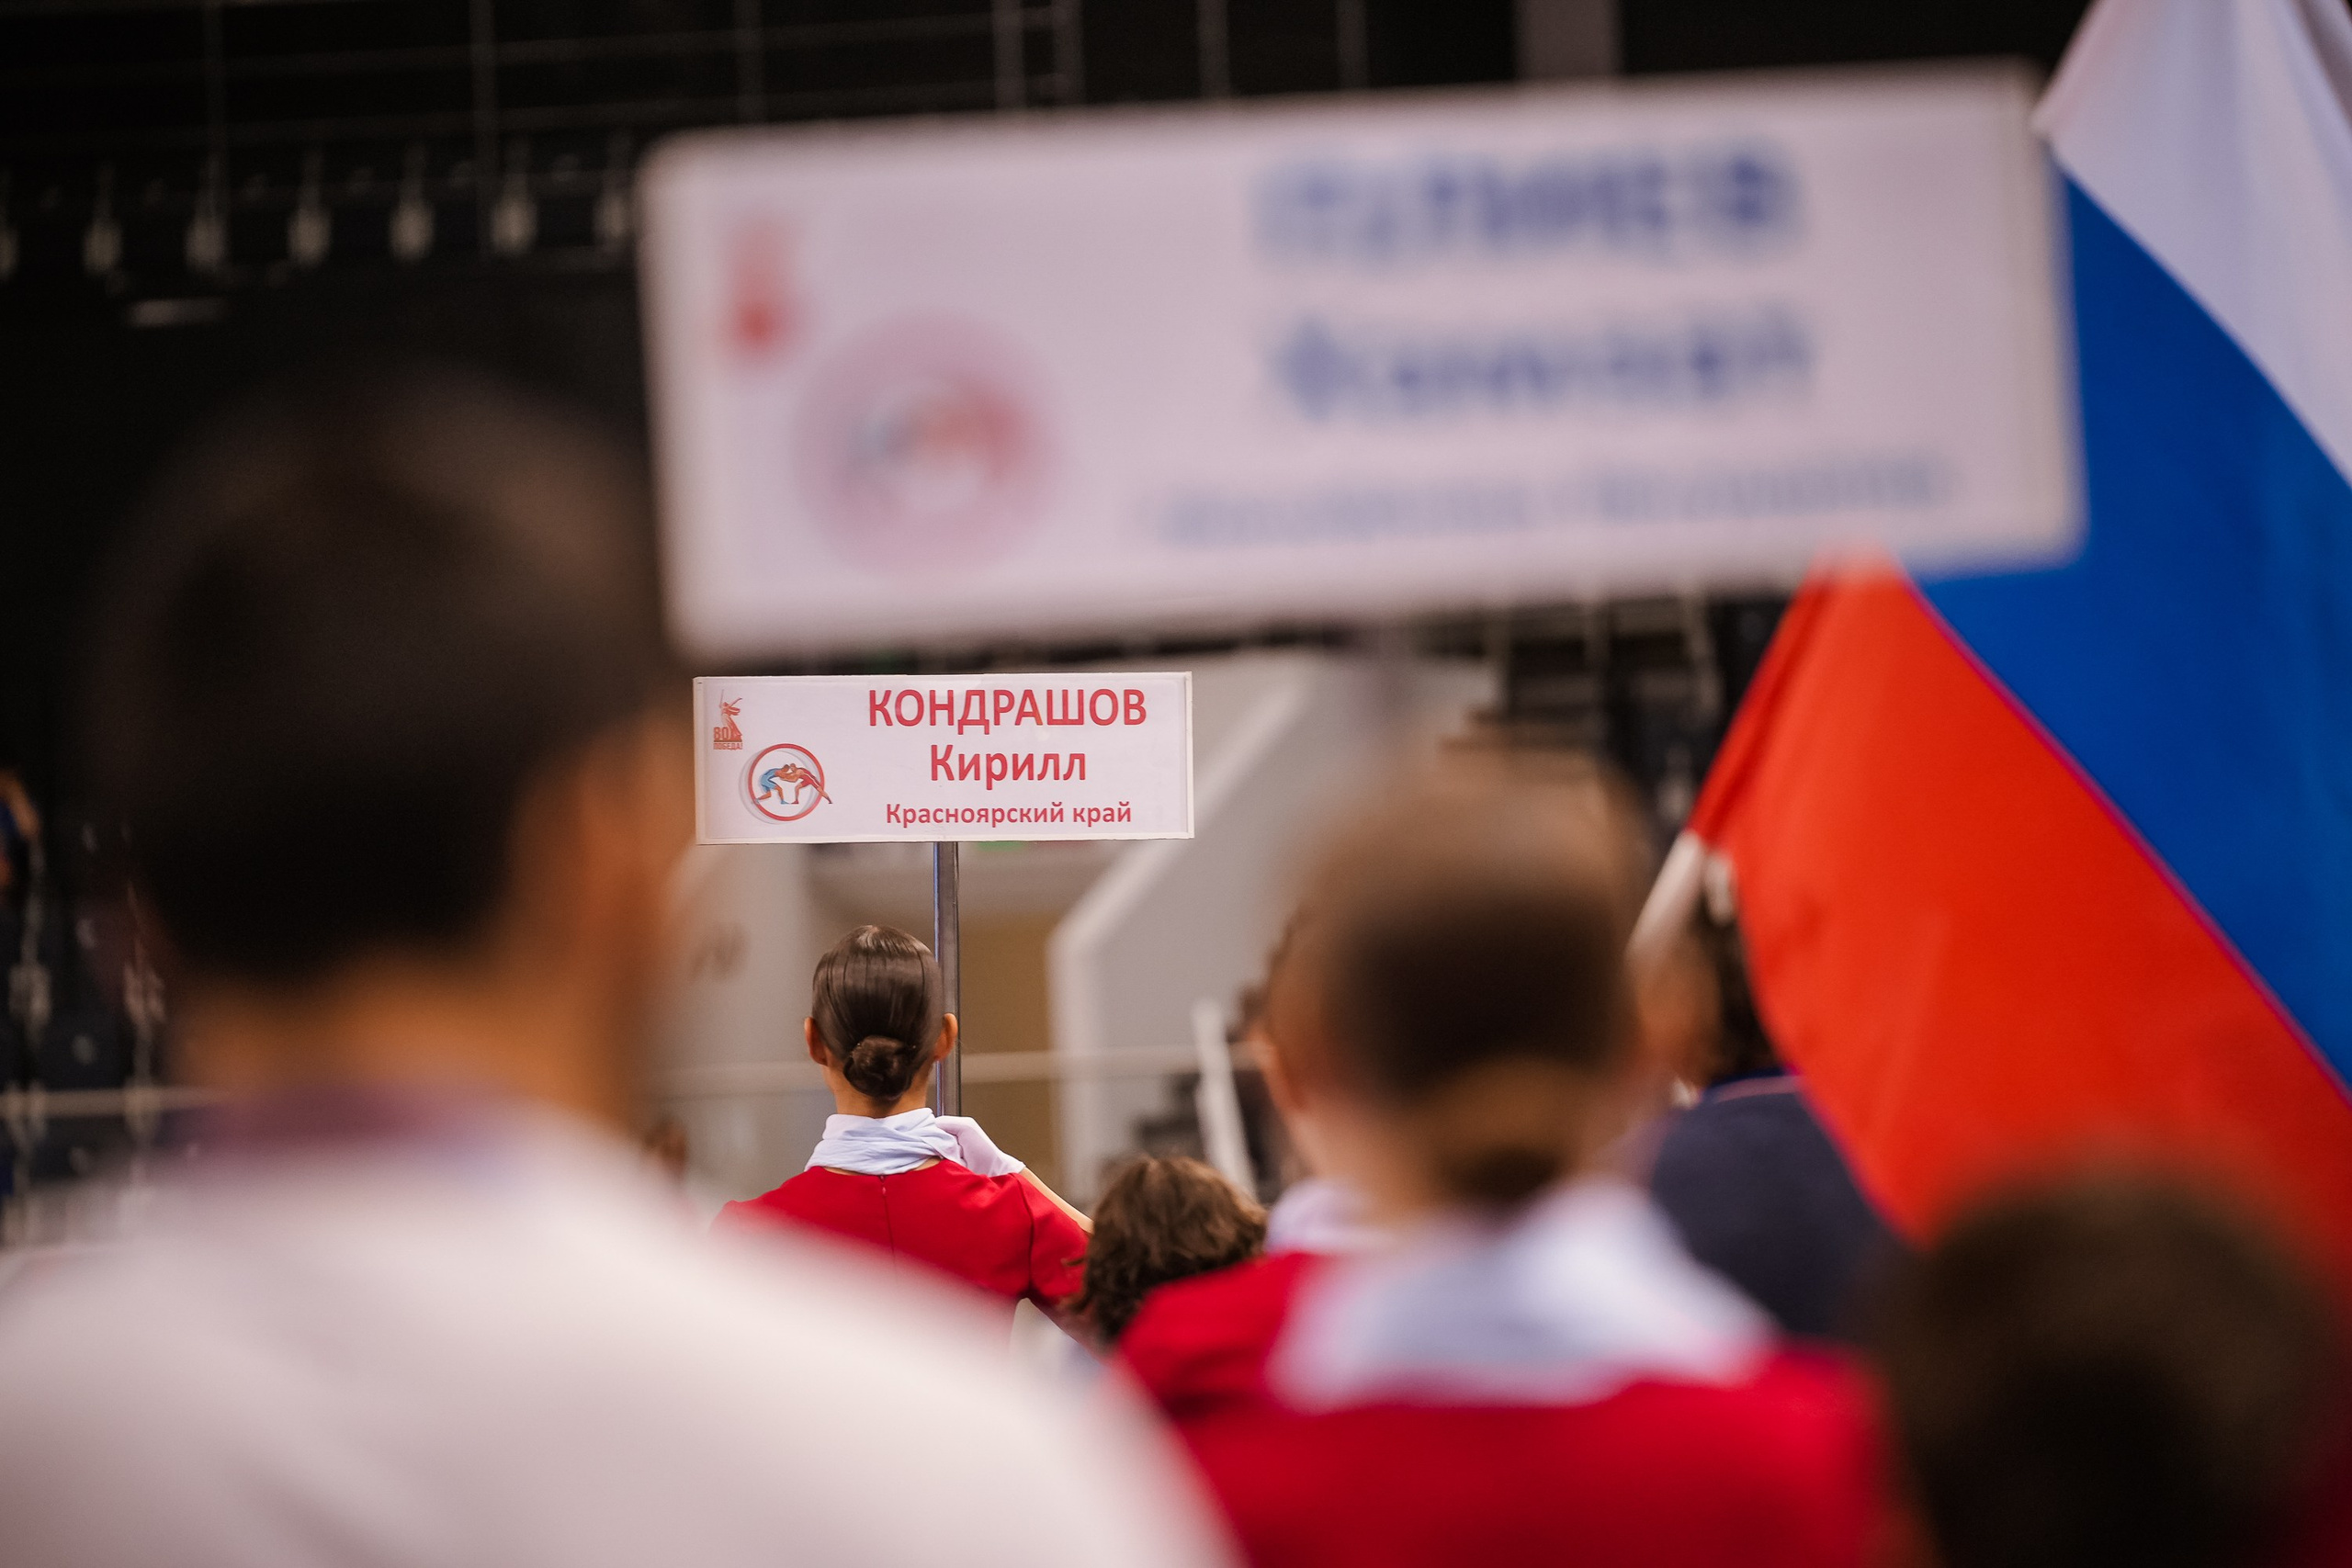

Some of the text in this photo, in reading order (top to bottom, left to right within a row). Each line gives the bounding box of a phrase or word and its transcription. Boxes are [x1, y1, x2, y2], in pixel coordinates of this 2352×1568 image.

[868, 688, 1148, 735] КОНДРАШОВ
[931, 744, 1087, 790] Кирилл
[887, 801, 1132, 828] Красноярский край
